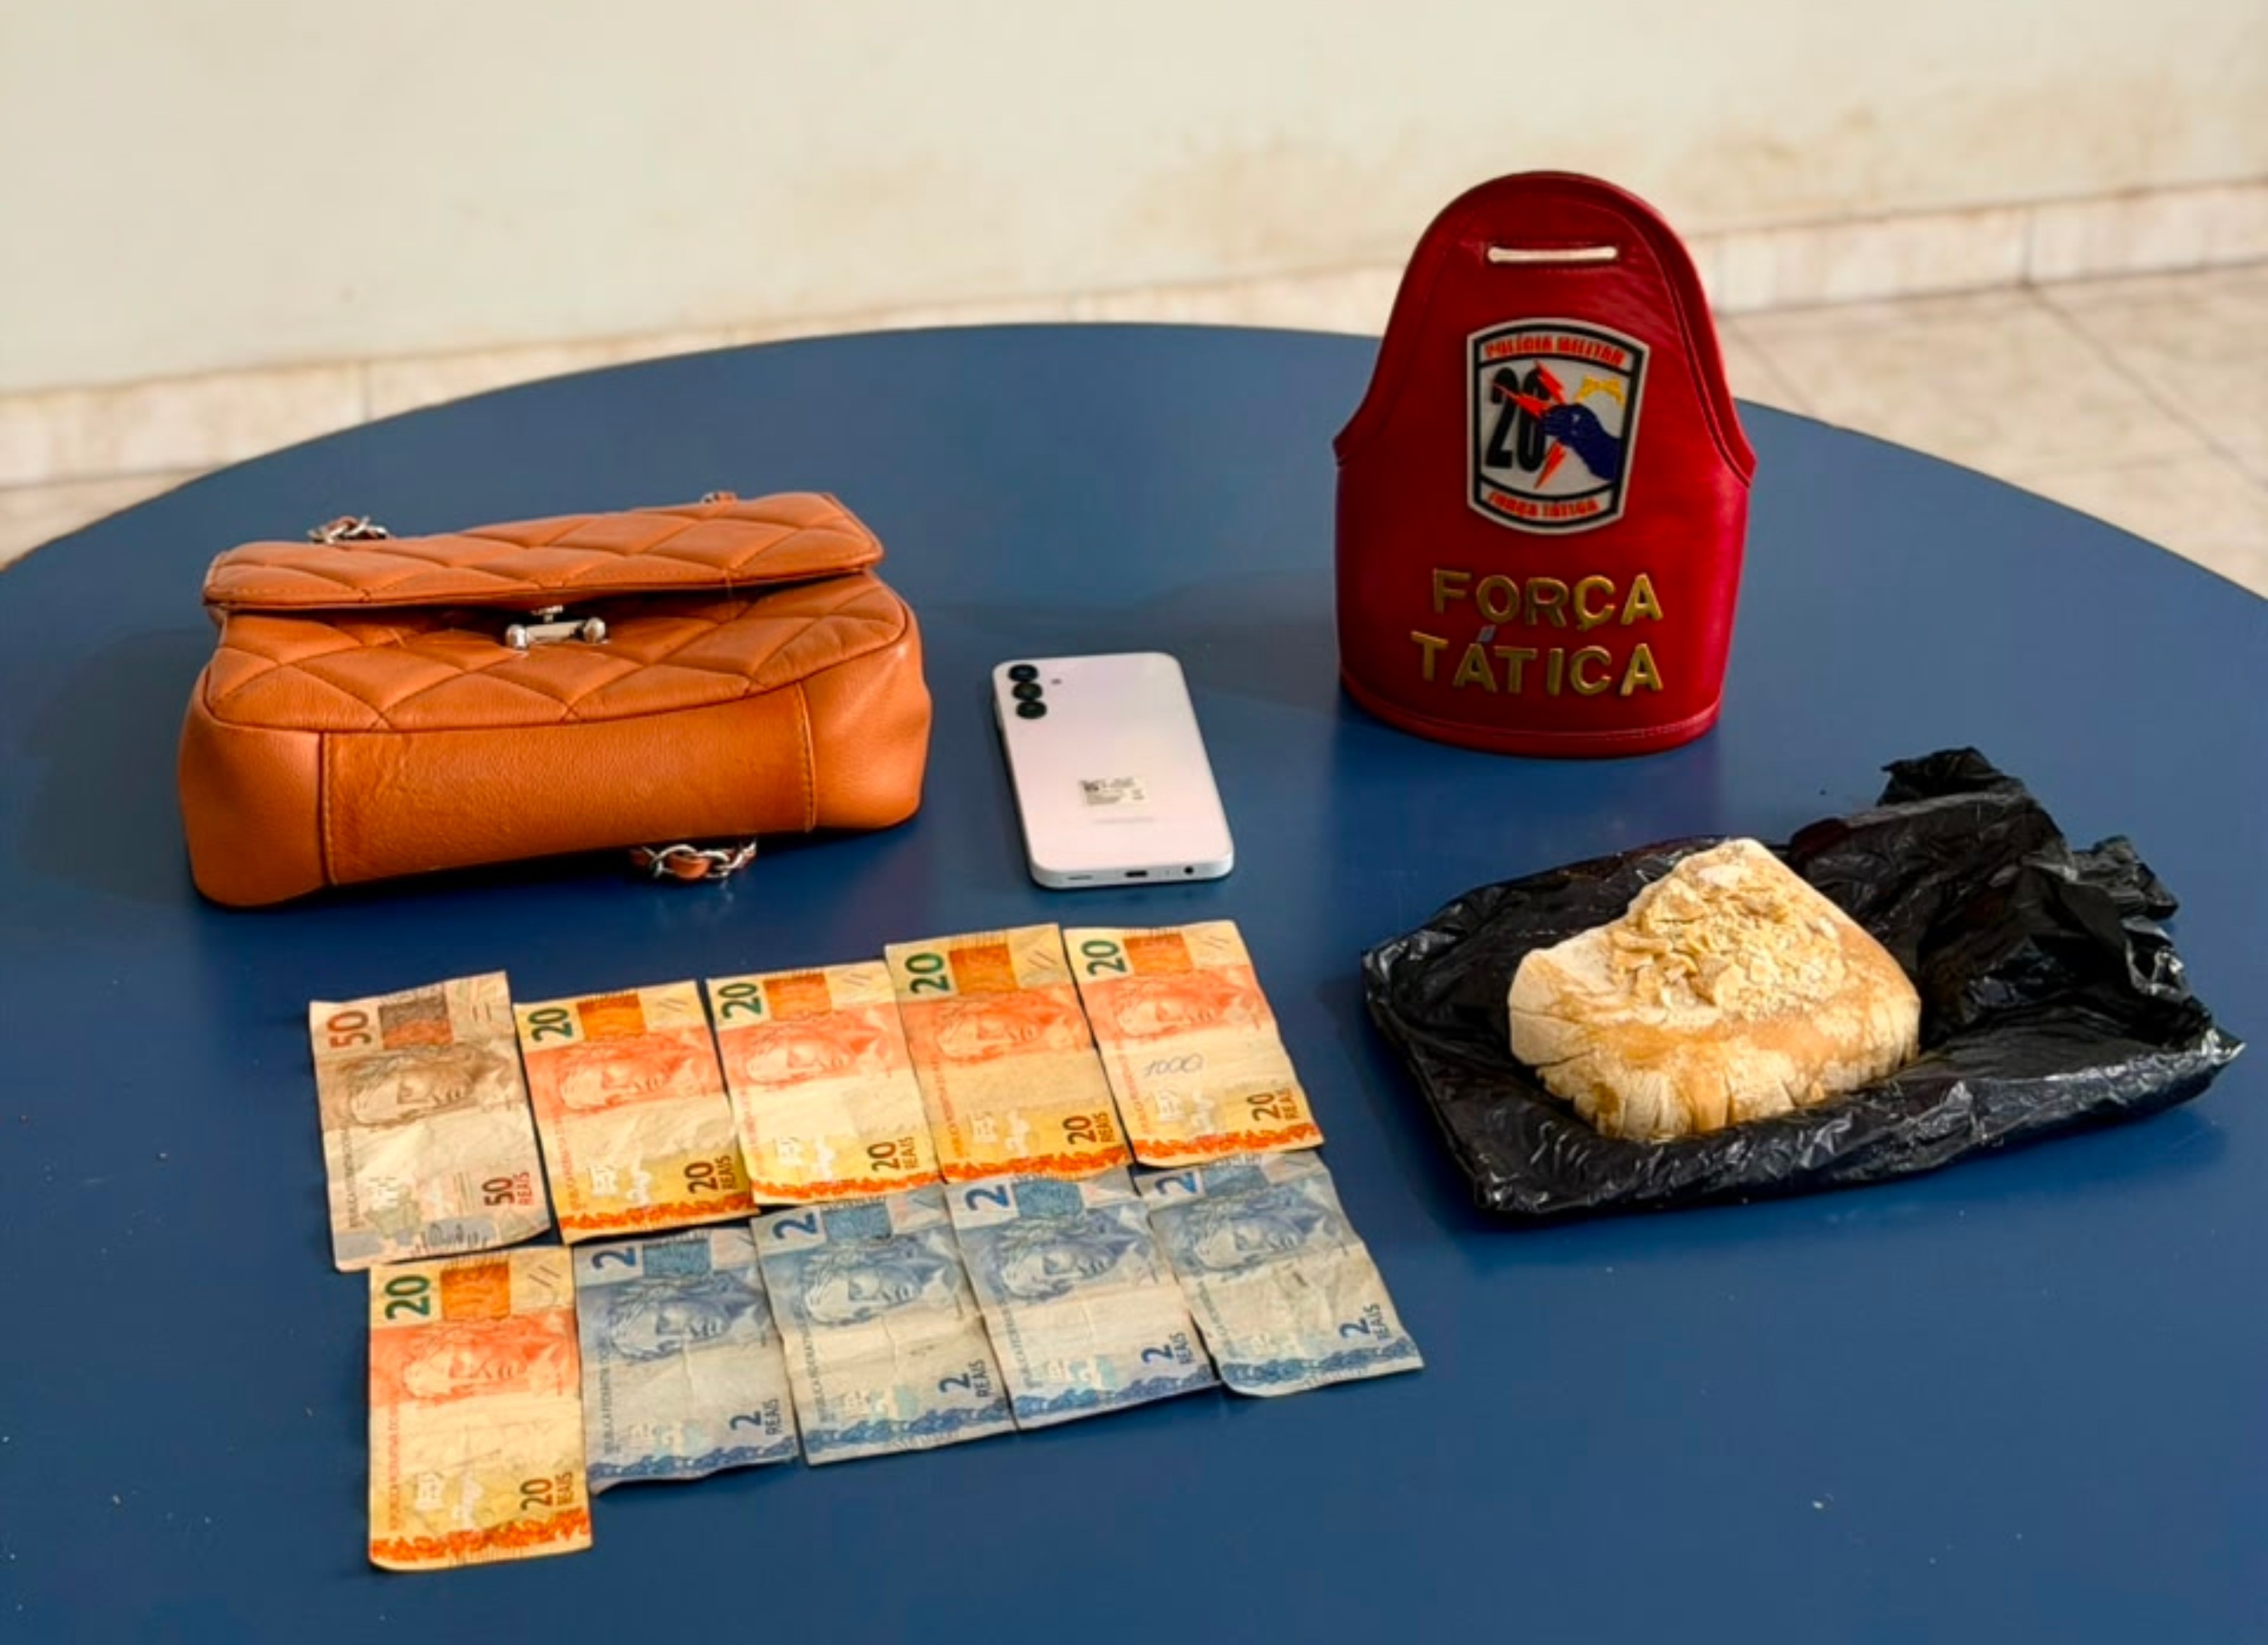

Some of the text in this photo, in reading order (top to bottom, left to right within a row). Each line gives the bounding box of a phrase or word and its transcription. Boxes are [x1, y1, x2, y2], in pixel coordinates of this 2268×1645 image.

[1432, 568, 1663, 631] FORÇA
[1409, 624, 1663, 696] TÁTICA
[1081, 940, 1128, 975] 20
[905, 952, 951, 994] 20
[718, 982, 762, 1019] 20
[327, 1010, 372, 1048] 50
[528, 1007, 573, 1042] 20
[1247, 1092, 1281, 1121] 20
[1062, 1115, 1096, 1145] 20
[867, 1142, 901, 1171] 20
[482, 1177, 515, 1206] 50
[685, 1161, 718, 1194] 20
[1156, 1172, 1197, 1194] 2
[964, 1184, 1011, 1211] 2
[773, 1212, 819, 1239] 2
[592, 1248, 636, 1270] 2
[384, 1275, 430, 1320] 20
[1339, 1317, 1372, 1339] 2
[1141, 1344, 1175, 1364] 2
[939, 1373, 971, 1393] 2
[730, 1410, 761, 1430] 2
[520, 1478, 552, 1511] 20
